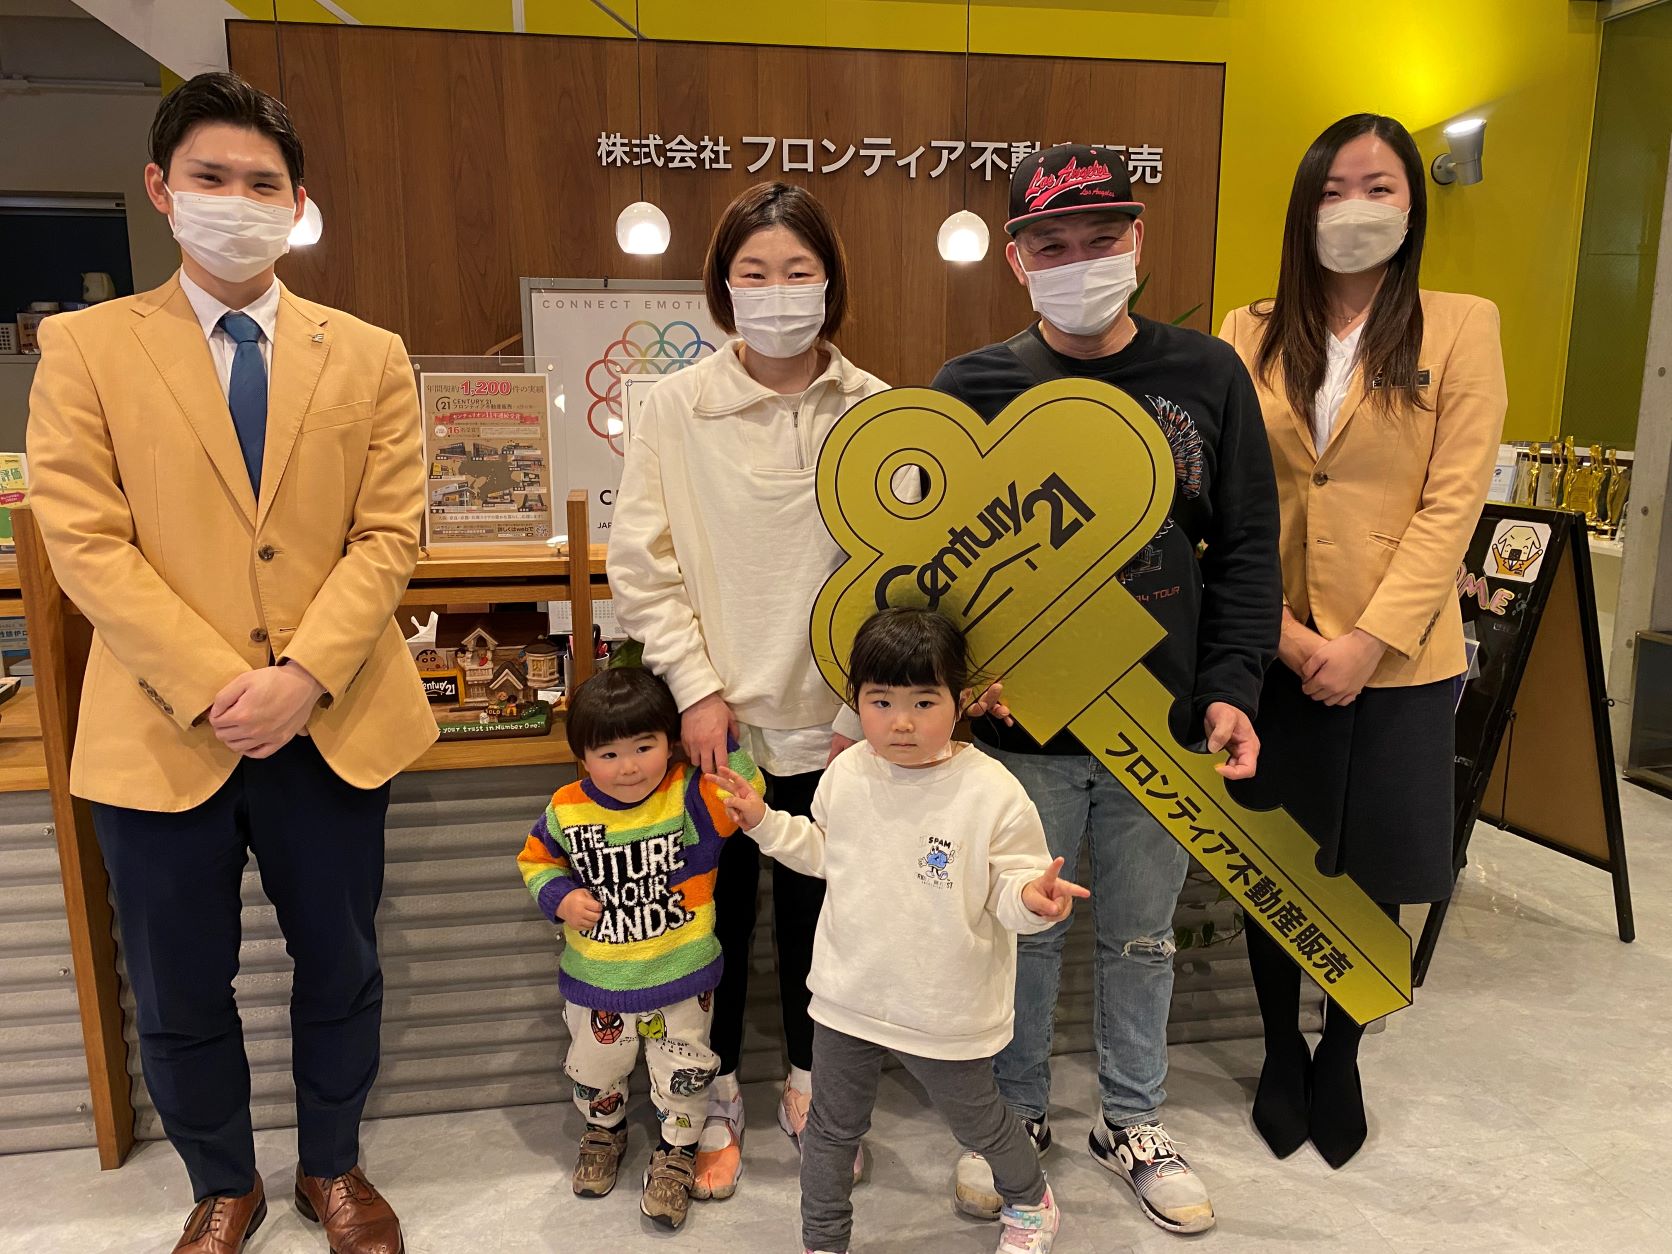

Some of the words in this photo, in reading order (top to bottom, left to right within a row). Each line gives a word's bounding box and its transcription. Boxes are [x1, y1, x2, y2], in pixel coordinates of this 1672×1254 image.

[597, 131, 731, 170] 株式会社
[742, 135, 1163, 185] フロンティア不売
[1025, 166, 1057, 203] Los
[542, 299, 631, 310] CONNECT
[644, 300, 702, 310] EMOTI
[875, 480, 1020, 613] Century
[1022, 472, 1097, 551] 21
[1152, 585, 1181, 600] TOUR
[421, 680, 448, 691] entury
[445, 683, 456, 695] 21
[462, 725, 484, 733] trust
[495, 723, 523, 731] Number
[564, 825, 605, 854] THE
[928, 836, 951, 849] SPAM
[571, 830, 686, 886] FUTURE
[1105, 731, 1354, 984] フロンティア不動産販売
[621, 874, 670, 906] OUR
[582, 893, 695, 943] ANDS.
